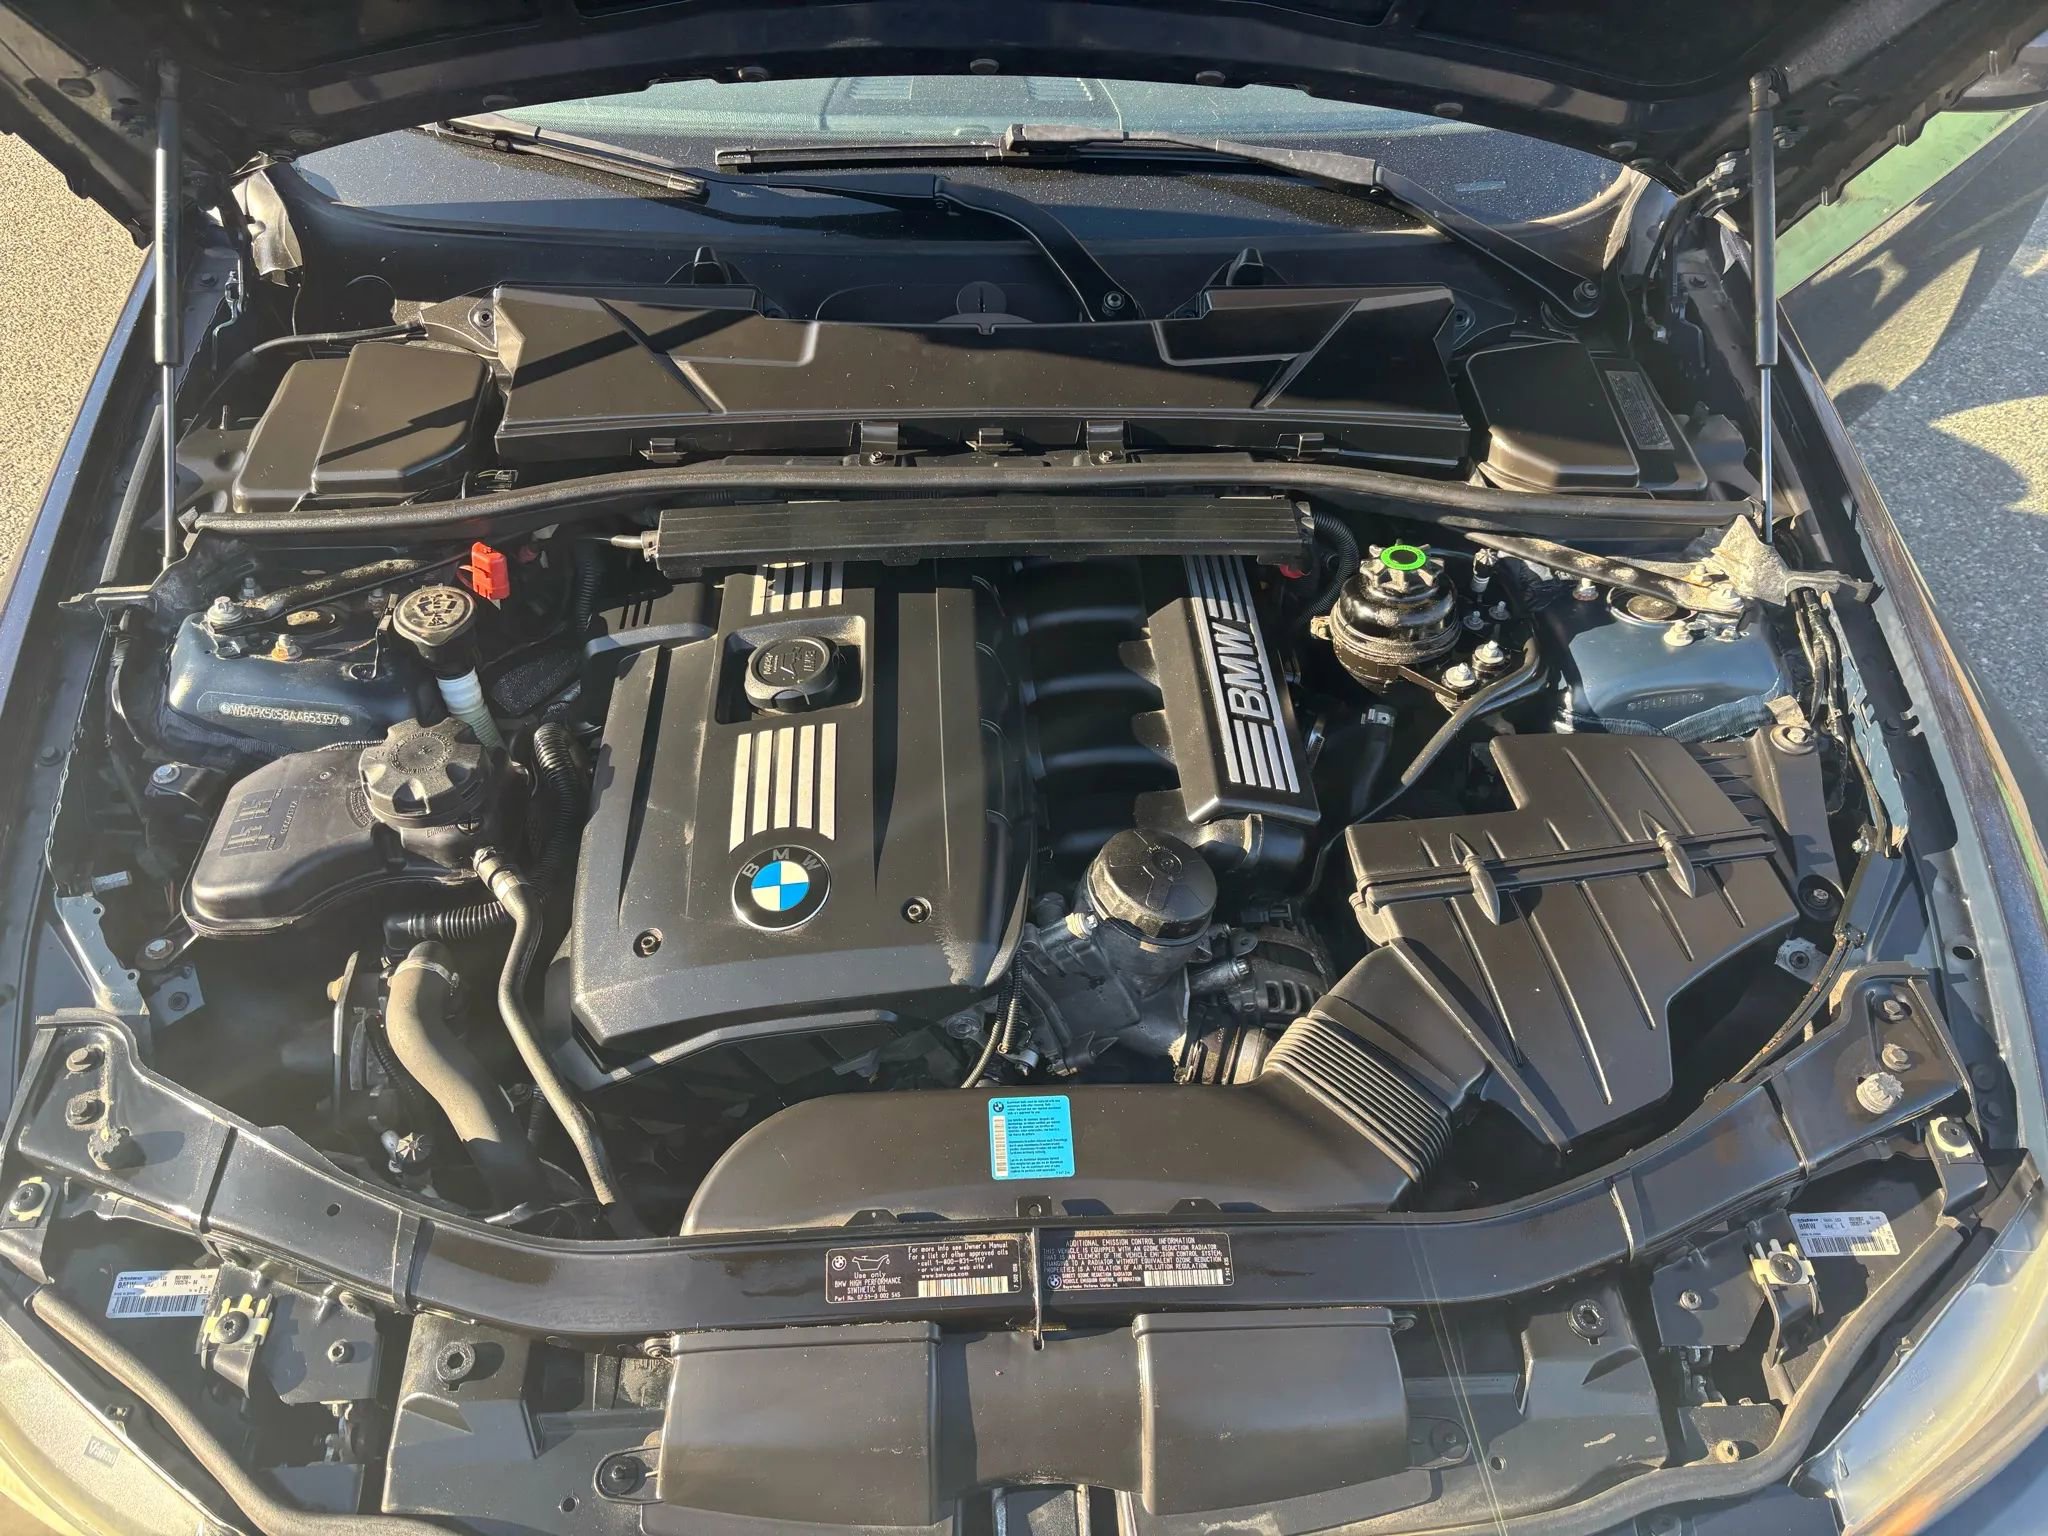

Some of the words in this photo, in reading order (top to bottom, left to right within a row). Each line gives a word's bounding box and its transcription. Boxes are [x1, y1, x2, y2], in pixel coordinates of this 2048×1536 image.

[1211, 622, 1270, 720] BMW
[231, 703, 339, 726] WBAPK5C58AA653357
[742, 848, 822, 878] BMW
[988, 1241, 1008, 1249] Manual
[969, 1249, 994, 1258] approved
[870, 1270, 886, 1279] only
[864, 1276, 902, 1286] PERFORMANCE
[848, 1286, 876, 1294] SYNTHETIC
